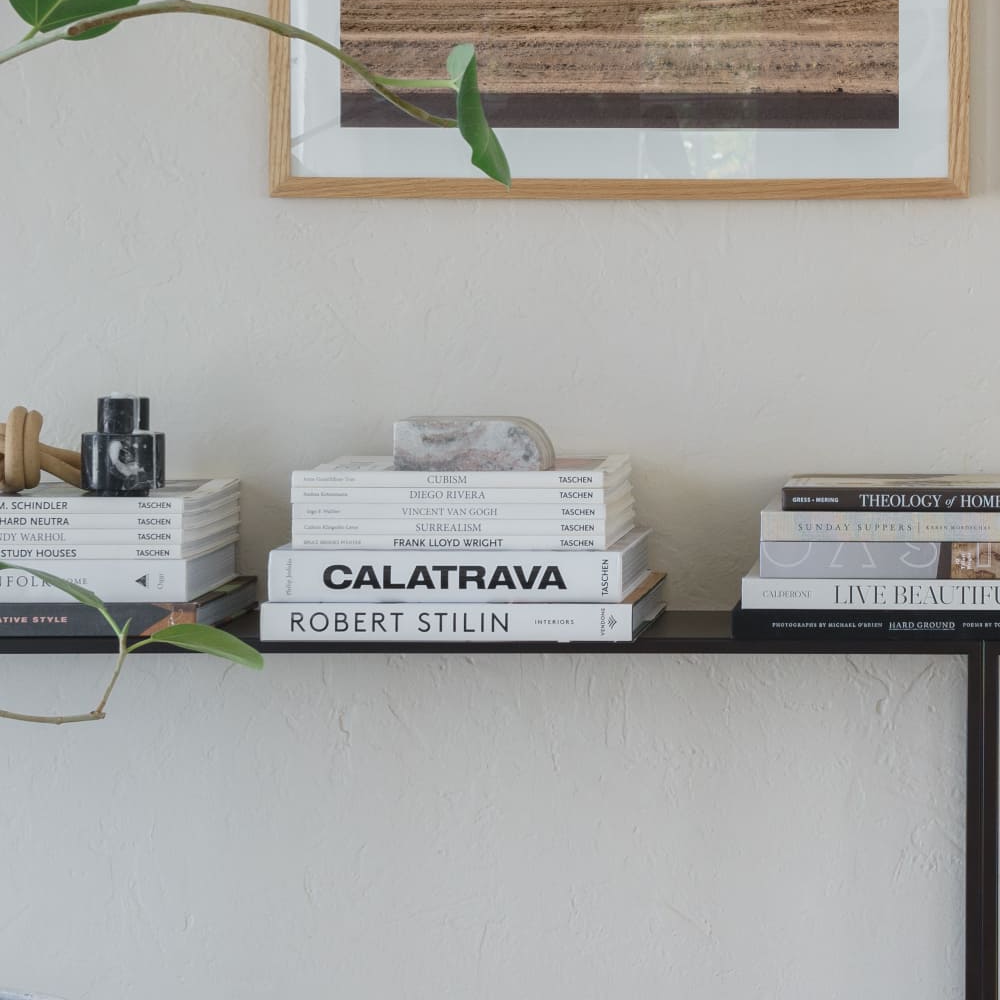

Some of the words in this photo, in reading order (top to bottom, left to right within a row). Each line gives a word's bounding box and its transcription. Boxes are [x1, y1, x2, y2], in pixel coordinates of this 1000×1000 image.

[426, 475, 467, 484] CUBISM
[559, 476, 593, 484] TASCHEN
[409, 490, 444, 500] DIEGO
[446, 490, 486, 500] RIVERA
[560, 491, 593, 499] TASCHEN
[11, 501, 68, 510] SCHINDLER
[859, 493, 942, 508] THEOLOGY
[945, 495, 957, 509] of
[401, 507, 445, 516] VINCENT
[447, 507, 467, 516] VAN
[468, 507, 498, 516] GOGH
[561, 508, 595, 516] TASCHEN
[30, 517, 70, 526] NEUTRA
[415, 523, 482, 532] SURREALISM
[560, 524, 594, 532] TASCHEN
[798, 523, 851, 531] SUNDAY
[857, 523, 913, 531] SUPPERS
[0, 532, 17, 541] DY
[20, 532, 66, 541] WARHOL
[393, 538, 426, 547] FRANK
[428, 538, 461, 547] LLOYD
[462, 538, 504, 547] WRIGHT
[560, 539, 594, 547] TASCHEN
[0, 549, 33, 558] STUDY
[36, 549, 77, 558] HOUSES
[136, 549, 170, 557] TASCHEN
[0, 575, 51, 588] FOLK
[323, 564, 567, 590] CALATRAVA
[601, 558, 609, 597] TASCHEN
[834, 585, 887, 605] LIVE
[290, 612, 404, 632] ROBERT
[417, 612, 509, 632] STILIN
[889, 621, 915, 629] HARD
[916, 621, 956, 629] GROUND
